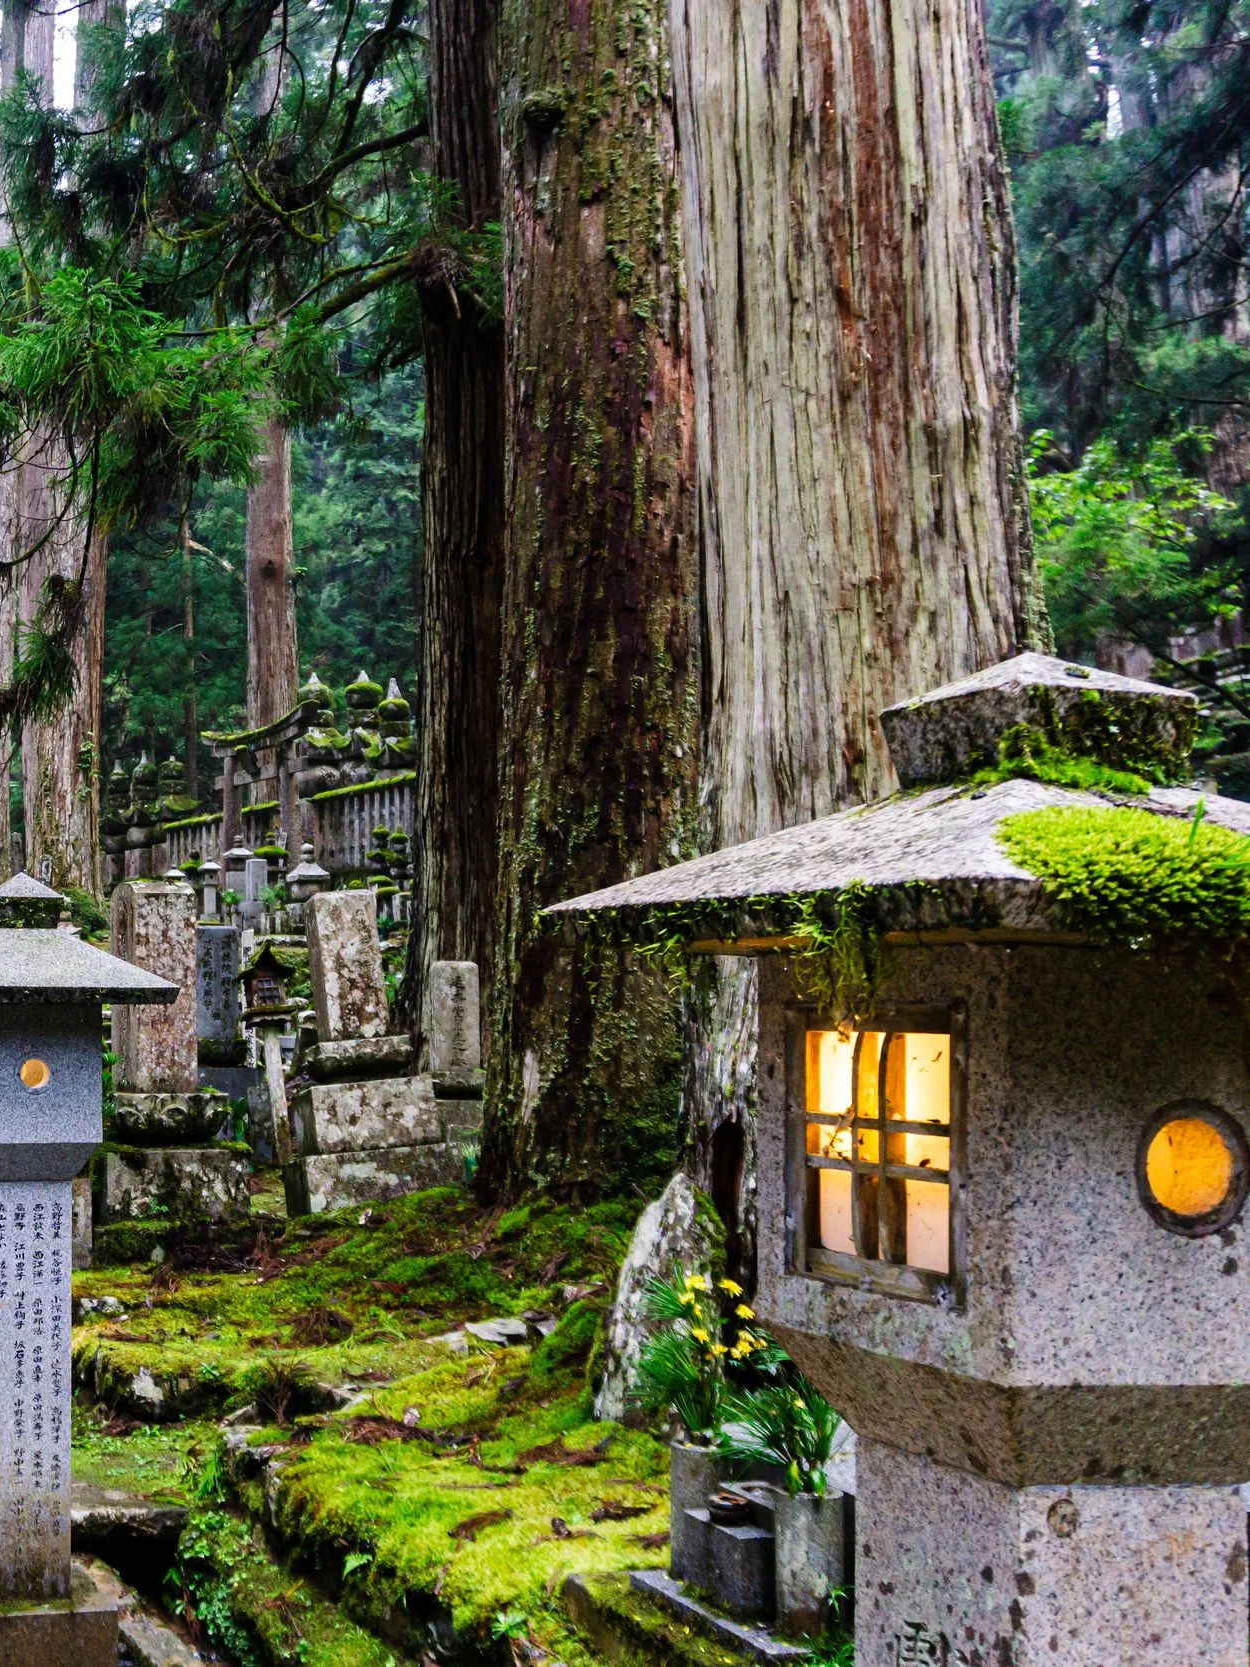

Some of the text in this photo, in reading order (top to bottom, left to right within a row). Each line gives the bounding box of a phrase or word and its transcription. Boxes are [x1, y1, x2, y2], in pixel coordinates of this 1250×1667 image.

[13, 1202, 26, 1231] 高野寺
[13, 1242, 26, 1281] 江川豊子
